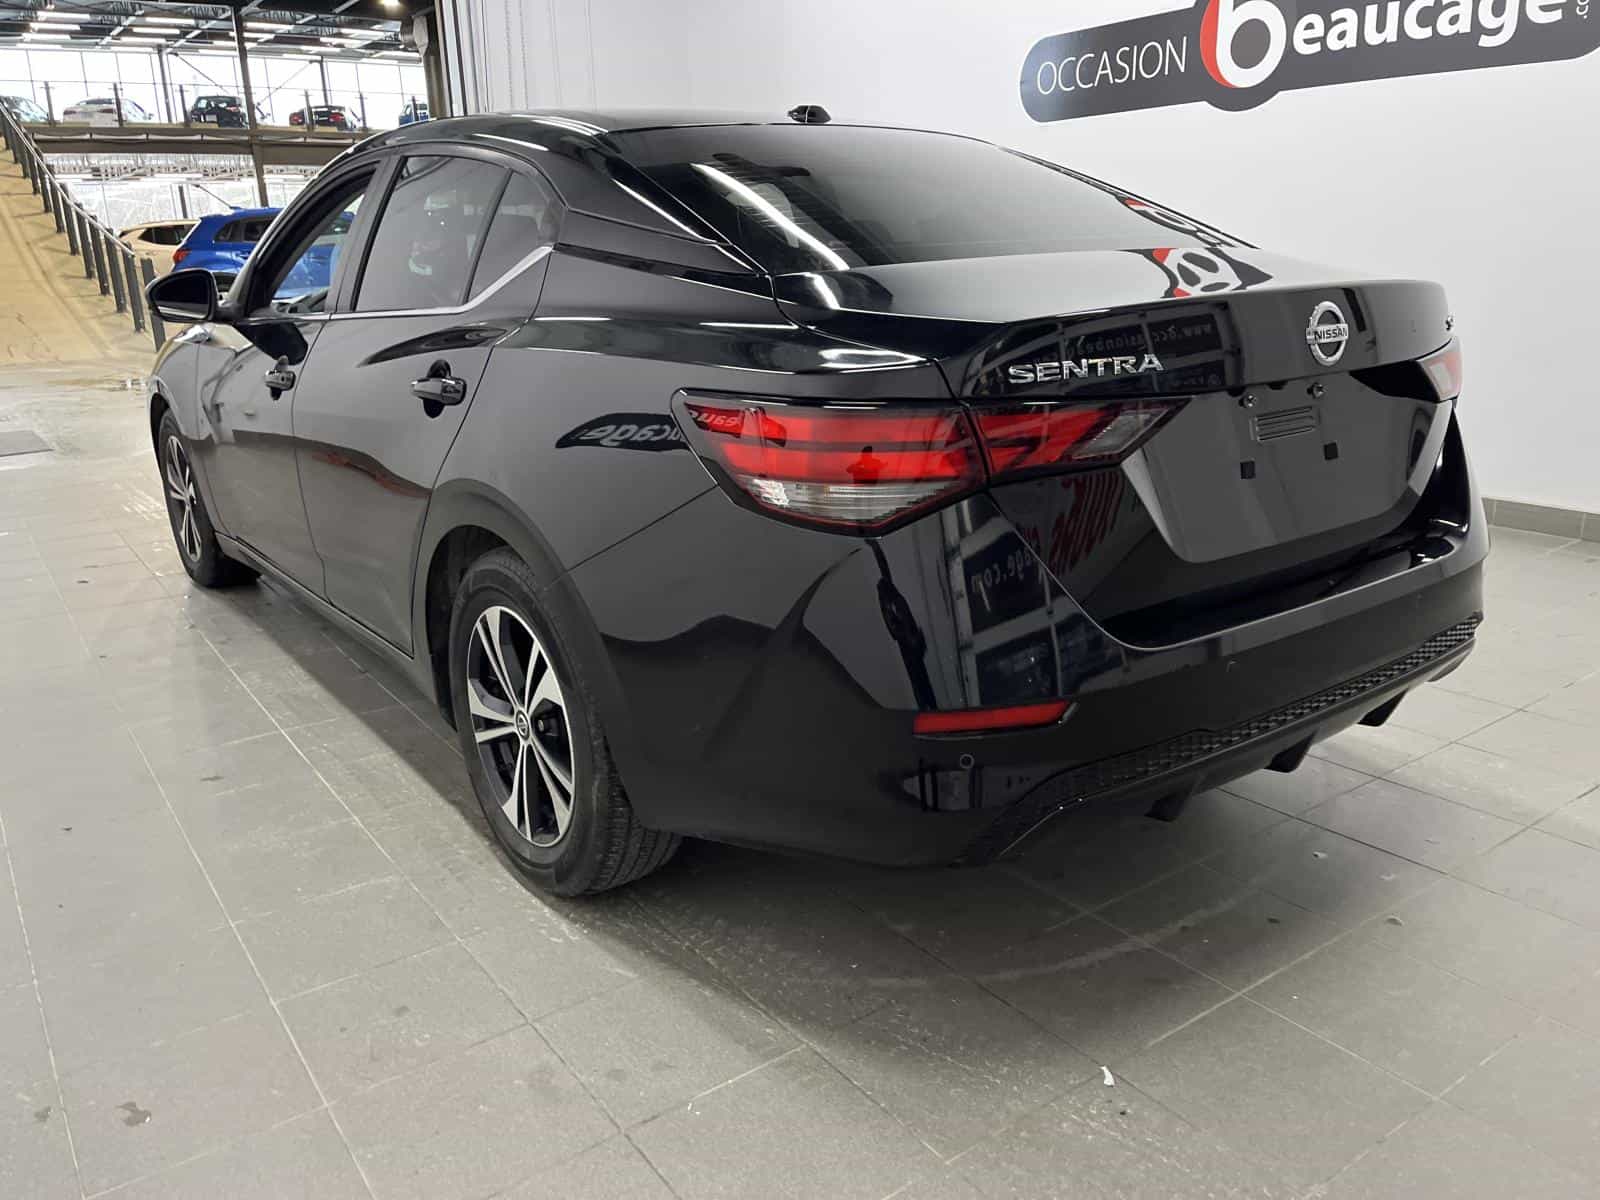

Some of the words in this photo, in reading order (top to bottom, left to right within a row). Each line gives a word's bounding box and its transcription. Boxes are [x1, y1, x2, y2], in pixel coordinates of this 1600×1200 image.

[1036, 37, 1188, 95] OCCASION
[1314, 326, 1349, 342] NISSAN
[1008, 353, 1165, 384] SENTRA
